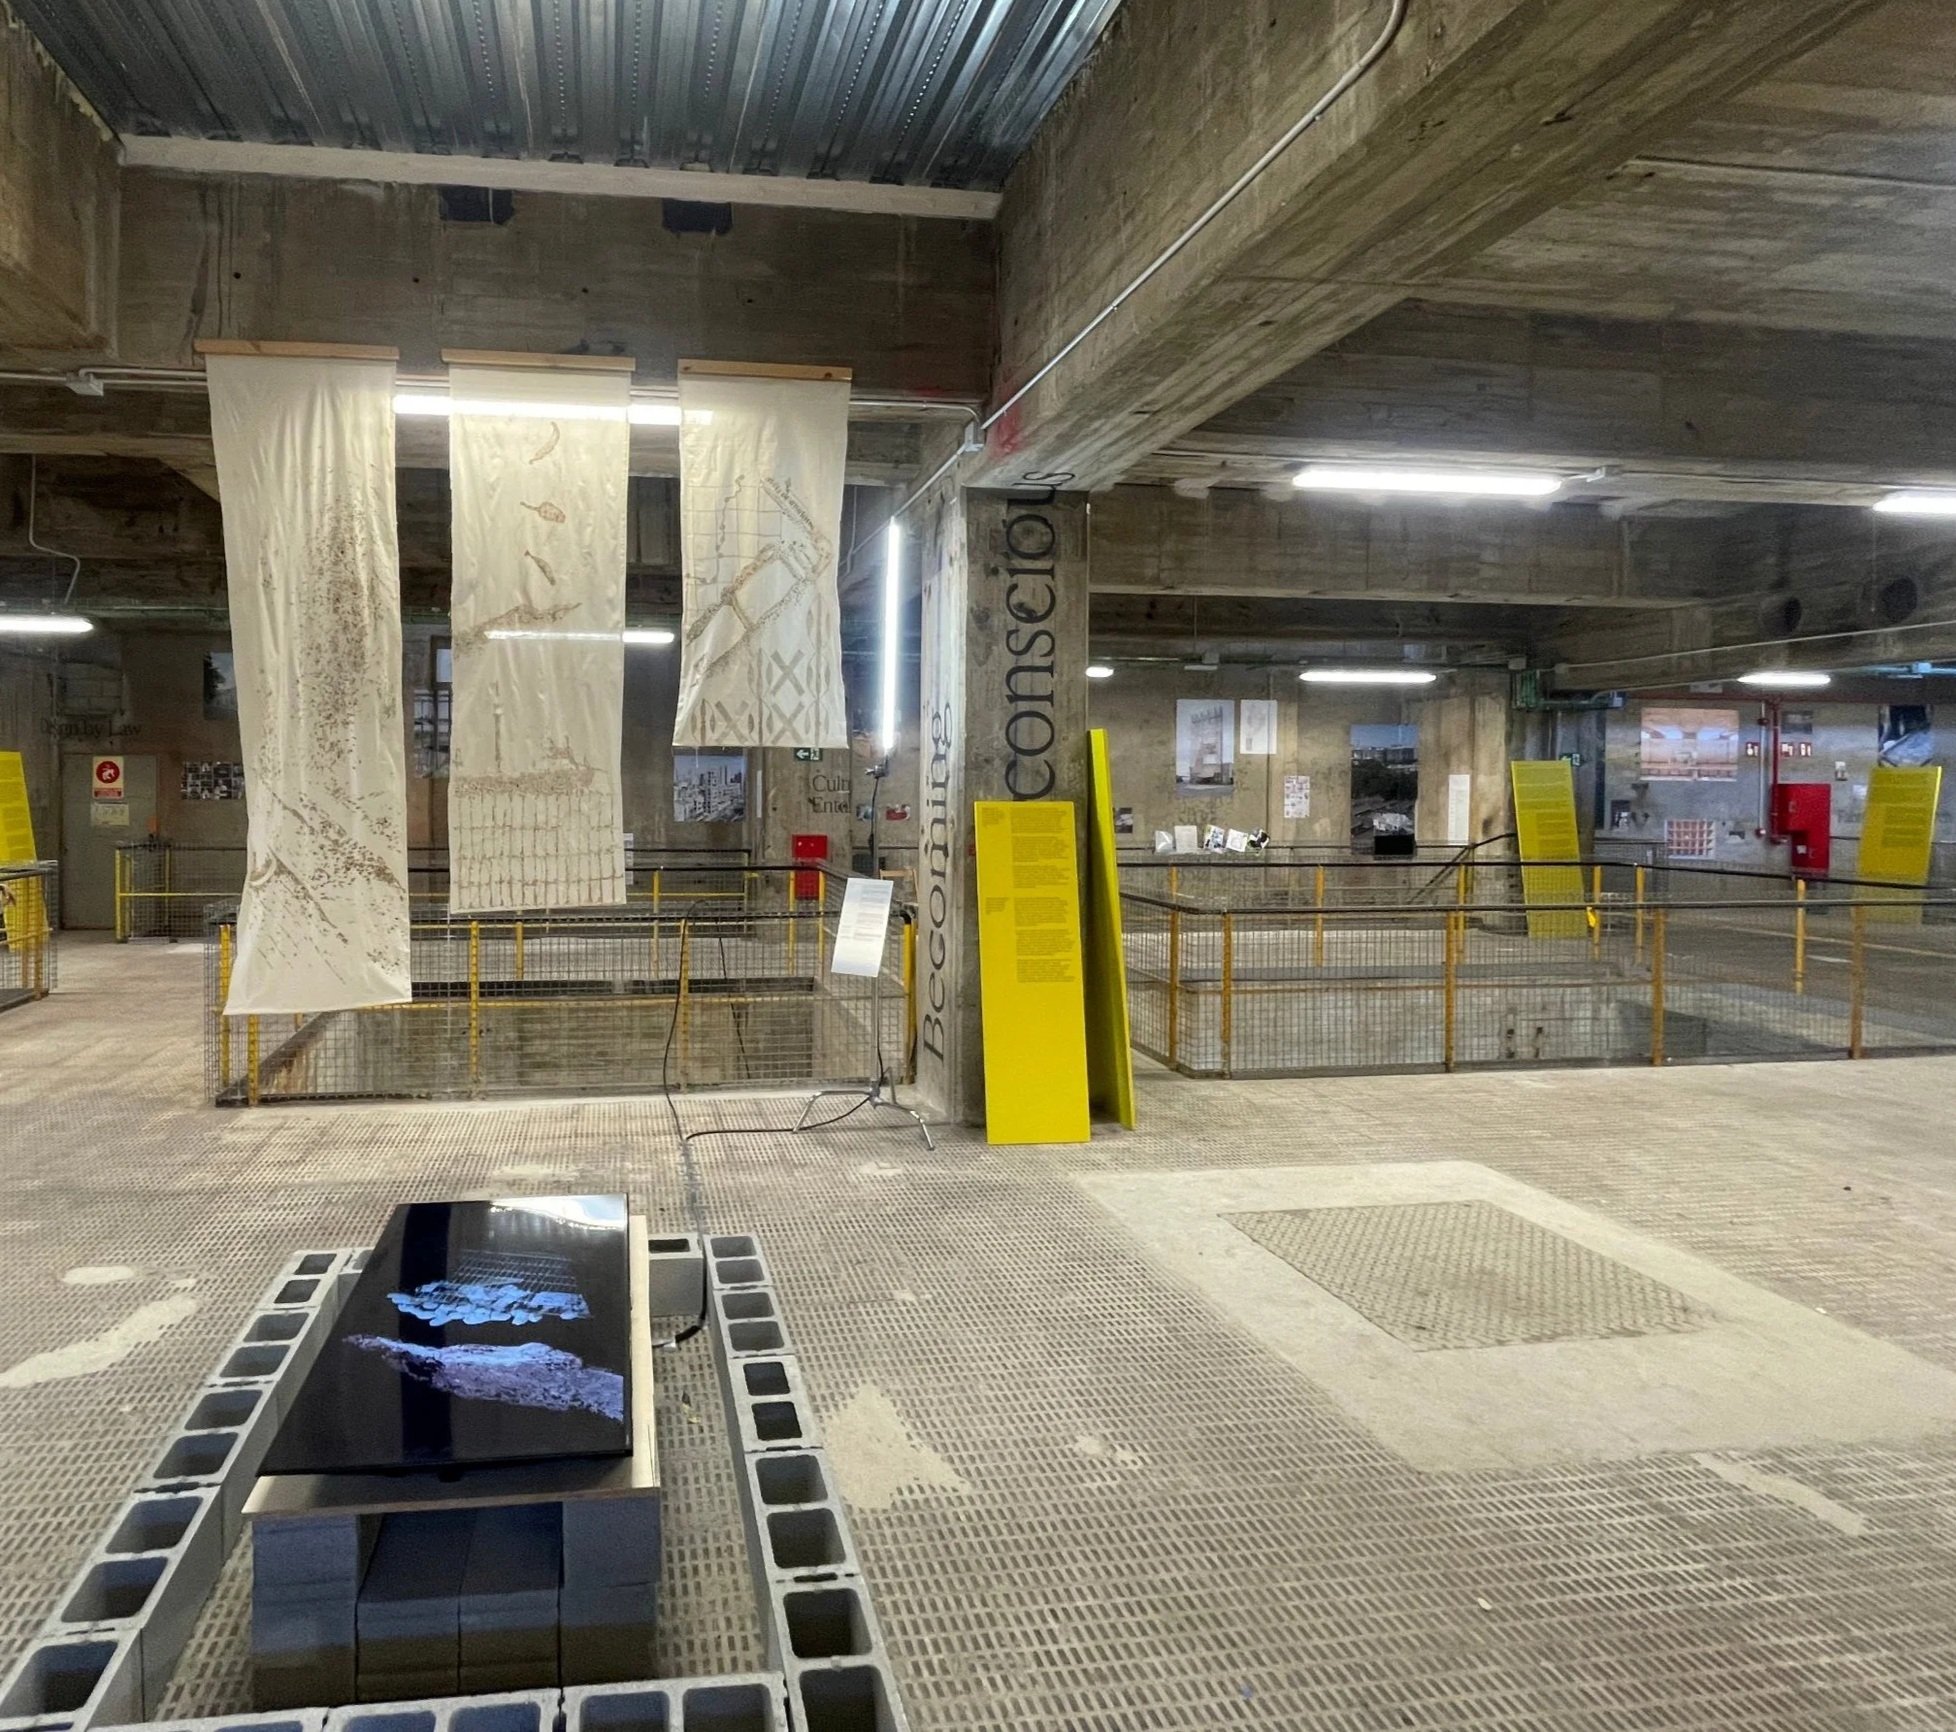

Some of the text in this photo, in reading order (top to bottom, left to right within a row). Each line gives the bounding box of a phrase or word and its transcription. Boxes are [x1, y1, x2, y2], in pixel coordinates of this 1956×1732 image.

[108, 719, 142, 737] Law
[1005, 470, 1076, 801] conscious
[922, 701, 953, 1064] Becoming
